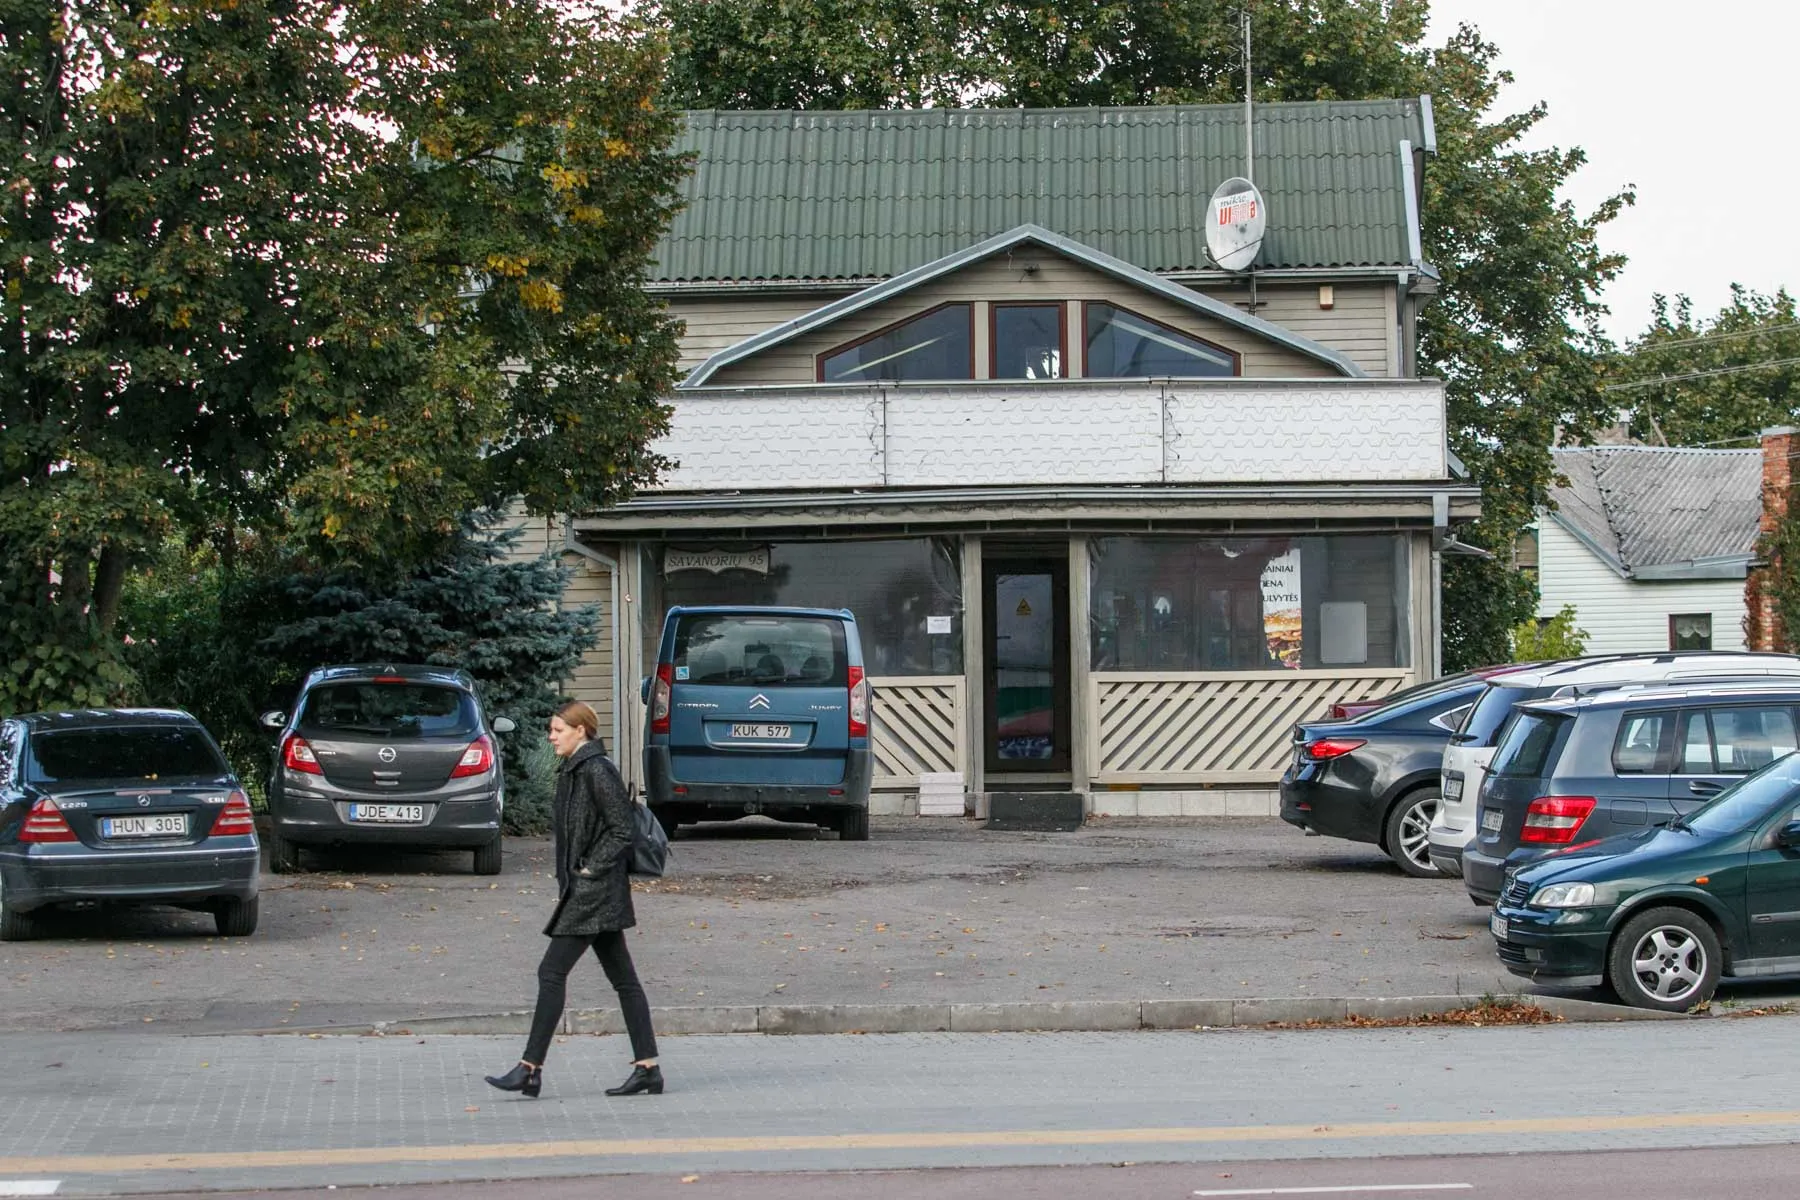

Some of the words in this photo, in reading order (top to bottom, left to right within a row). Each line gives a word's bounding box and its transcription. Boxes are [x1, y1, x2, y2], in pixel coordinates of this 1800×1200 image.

[748, 554, 764, 565] 95
[1264, 565, 1293, 573] AINIAI
[733, 725, 759, 737] KUK
[767, 726, 789, 737] 577
[358, 806, 387, 818] JDE
[396, 807, 421, 819] 413
[112, 819, 146, 833] HUN
[155, 818, 182, 832] 305
